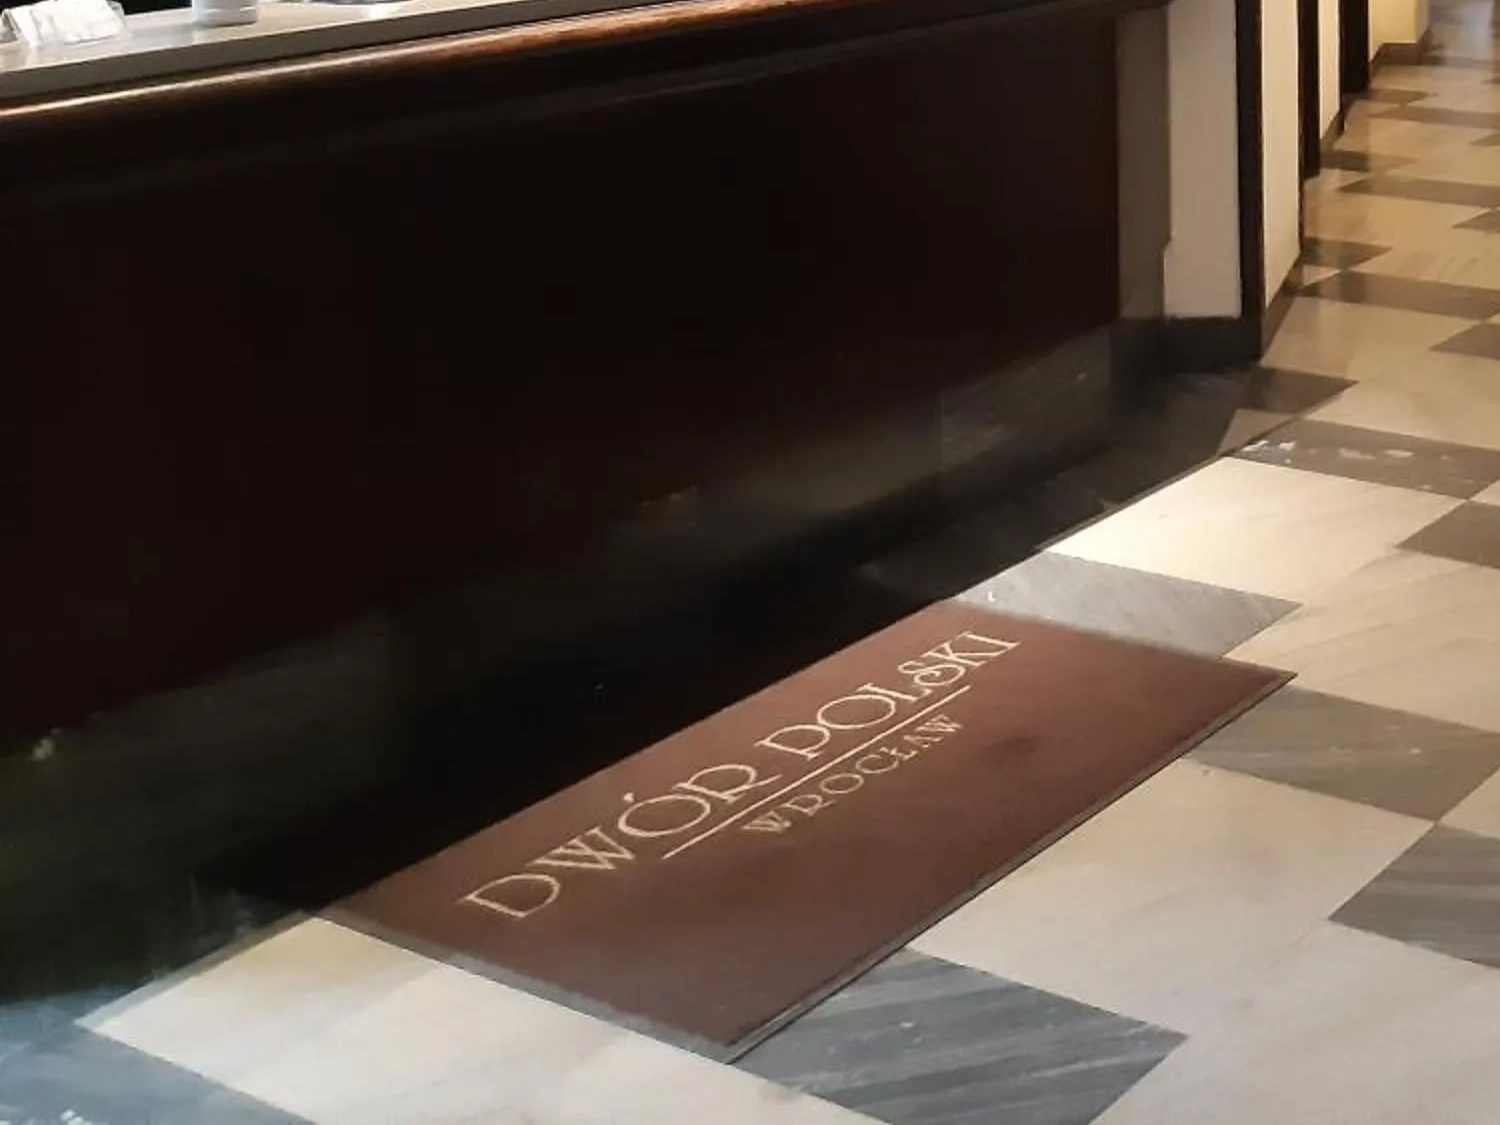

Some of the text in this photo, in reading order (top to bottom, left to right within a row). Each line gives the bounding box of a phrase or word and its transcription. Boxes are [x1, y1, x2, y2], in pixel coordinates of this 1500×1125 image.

[458, 631, 1020, 918] DWÓR POLSKI
[741, 713, 962, 833] WROCŁAW
